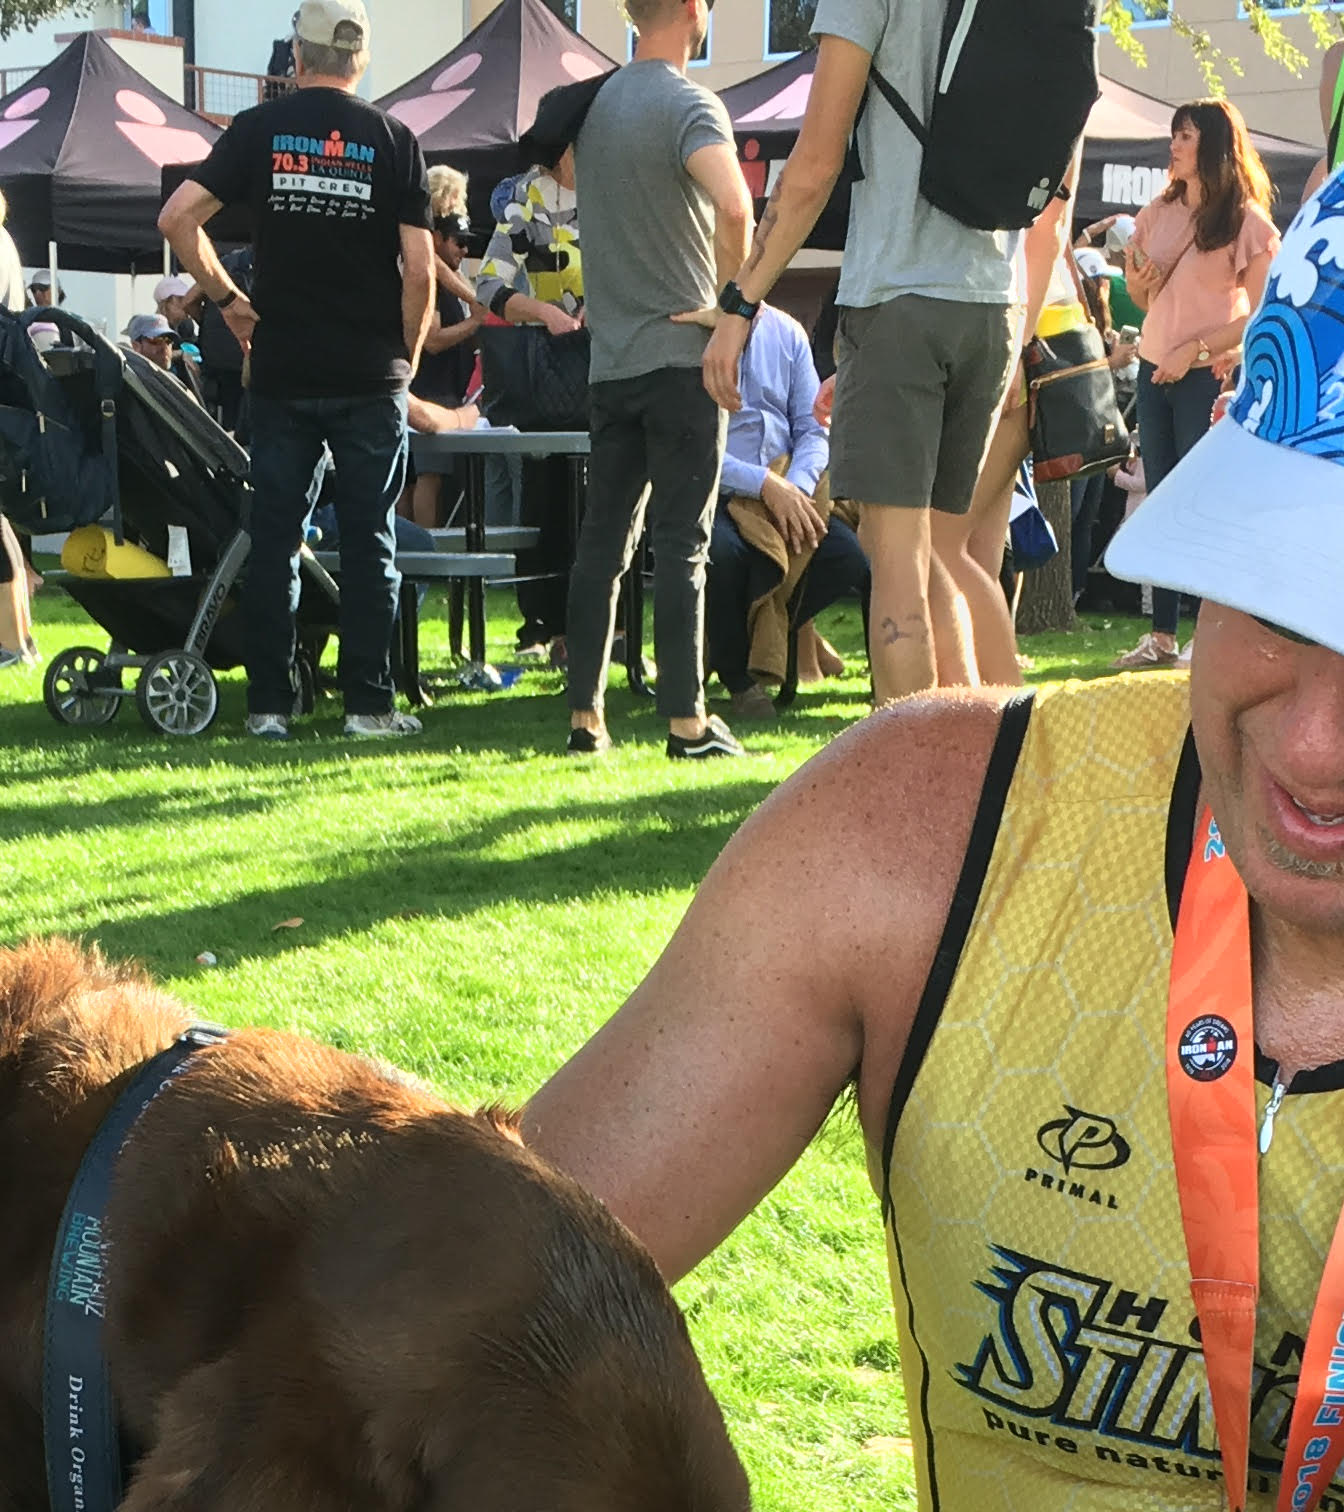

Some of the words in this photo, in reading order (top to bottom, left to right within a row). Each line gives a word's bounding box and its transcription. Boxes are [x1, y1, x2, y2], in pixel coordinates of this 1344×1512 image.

[272, 130, 375, 163] IRONMAN
[272, 152, 309, 172] 70.3
[280, 177, 306, 187] PIT
[318, 180, 364, 196] CREW
[1181, 1037, 1234, 1056] IRONMAN
[1024, 1167, 1119, 1210] PRIMAL
[69, 1374, 84, 1439] Drink
[982, 1406, 1078, 1454] pure
